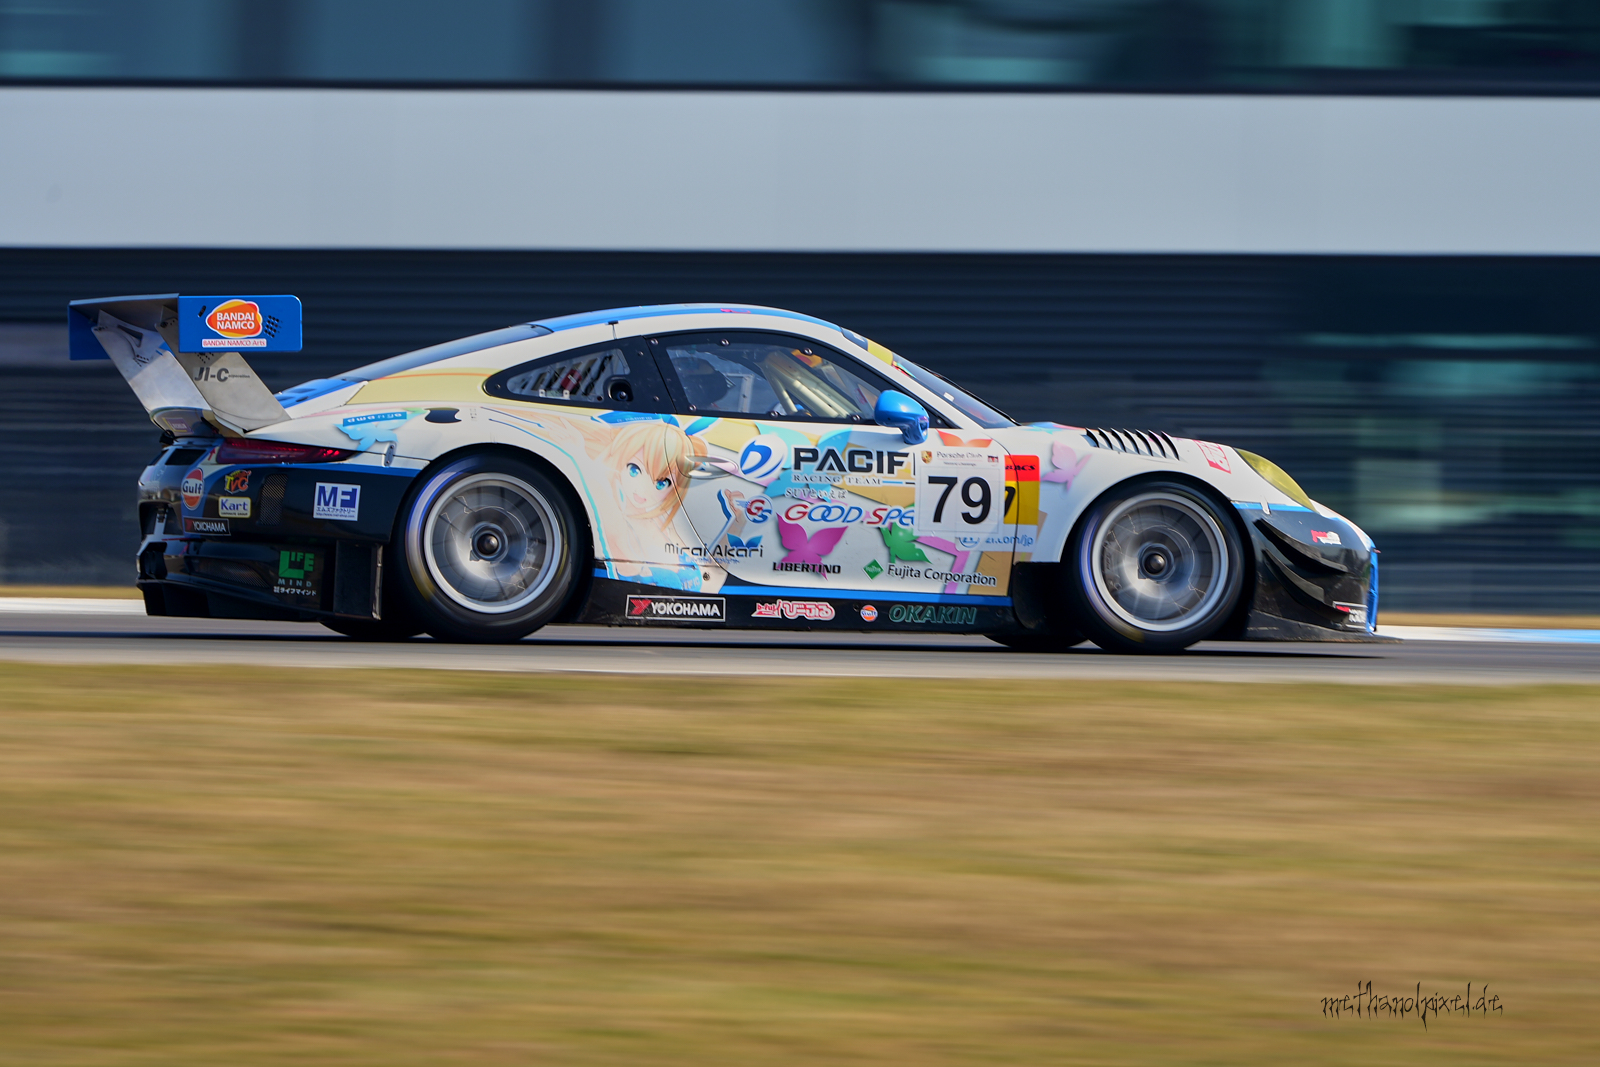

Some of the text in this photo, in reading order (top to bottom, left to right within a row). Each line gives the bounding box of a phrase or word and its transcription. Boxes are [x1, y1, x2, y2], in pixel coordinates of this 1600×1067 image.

[216, 312, 255, 321] BANDAI
[216, 321, 255, 330] NAMCO
[793, 474, 881, 486] RACING TEAM
[182, 480, 203, 495] Gulf
[221, 499, 249, 511] Kart
[928, 475, 992, 525] 79
[784, 503, 863, 523] GOOD
[193, 521, 227, 532] YOKOHAMA
[712, 544, 764, 558] Akari
[772, 561, 842, 574] LIBERTINO
[888, 564, 921, 579] Fujita
[924, 568, 997, 586] Corporation
[278, 578, 312, 587] MIND
[651, 602, 721, 617] YOKOHAMA
[888, 604, 977, 625] OKAKIN
